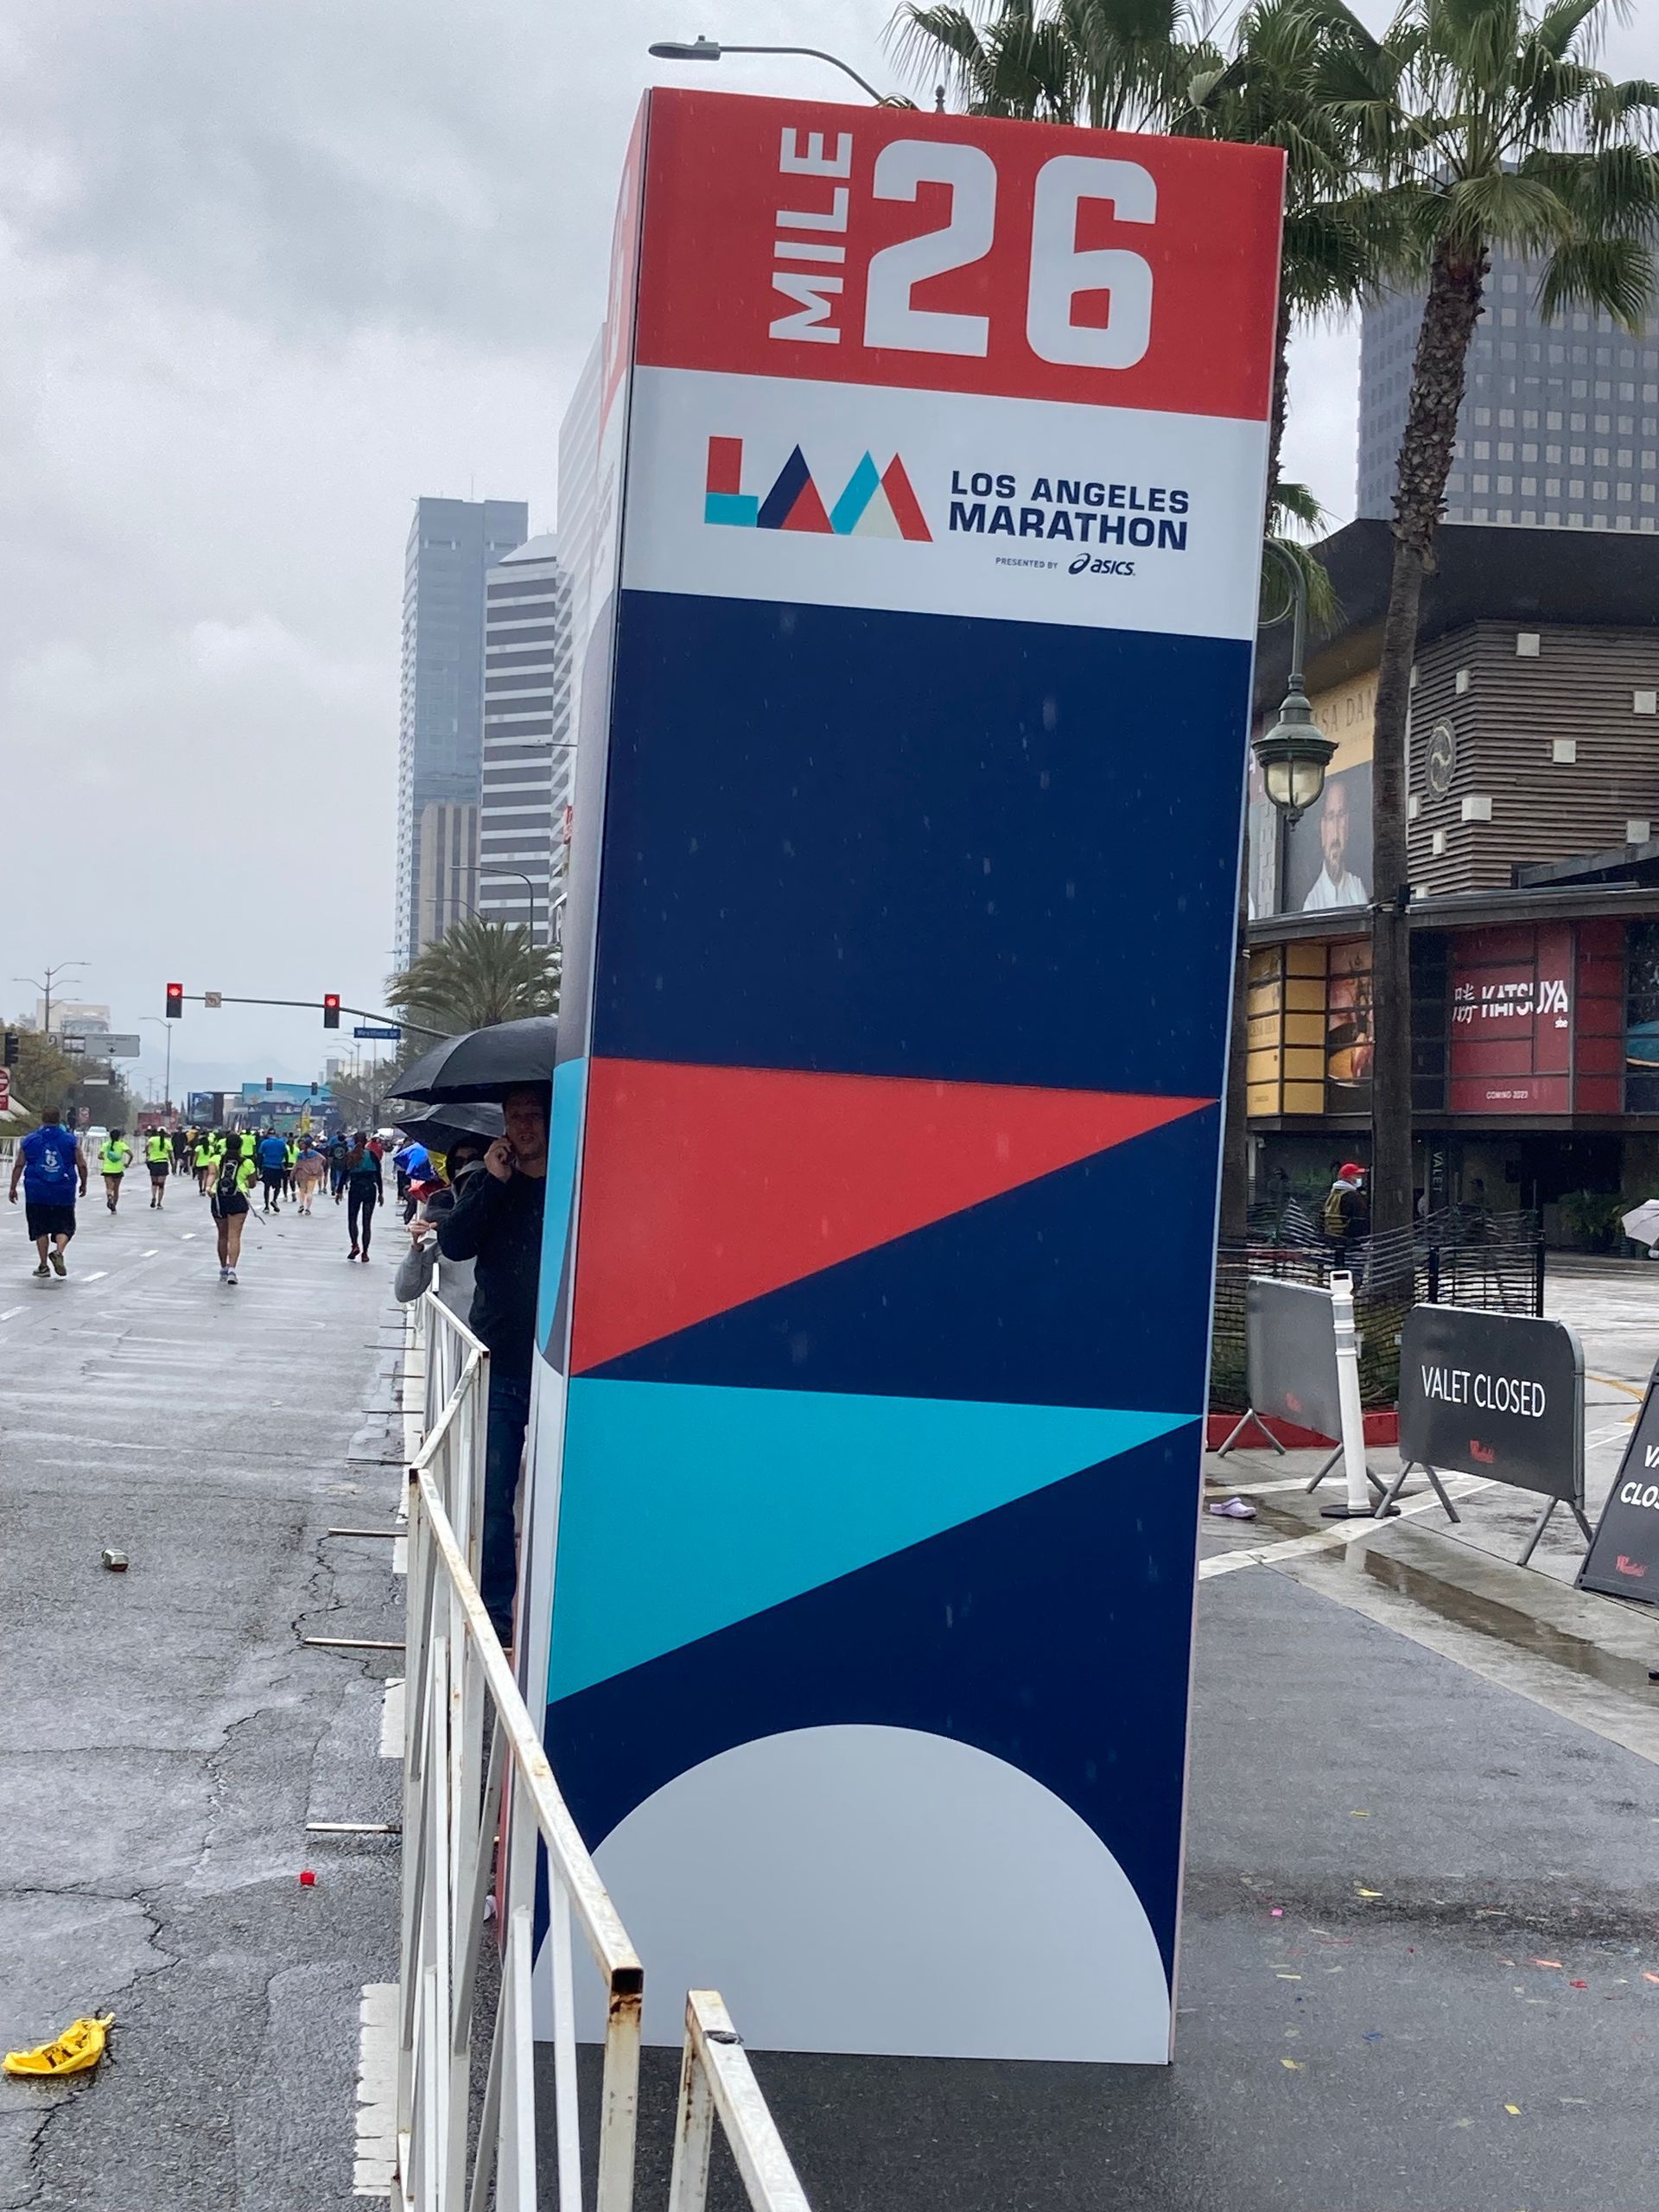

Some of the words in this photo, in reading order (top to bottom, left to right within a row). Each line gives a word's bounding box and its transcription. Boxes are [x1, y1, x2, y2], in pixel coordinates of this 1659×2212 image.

[769, 126, 854, 344] MILE
[864, 139, 1158, 370] 26
[950, 470, 1016, 499] LOS
[1030, 477, 1189, 514] ANGELES
[949, 501, 1187, 550] MARATHON
[995, 556, 1046, 569] PRESENTED
[1046, 561, 1058, 569] BY
[1481, 980, 1569, 1019] KATSUYA
[1433, 1151, 1444, 1192] VALET
[1421, 1364, 1471, 1404] VALET
[1474, 1373, 1546, 1418] CLOSED
